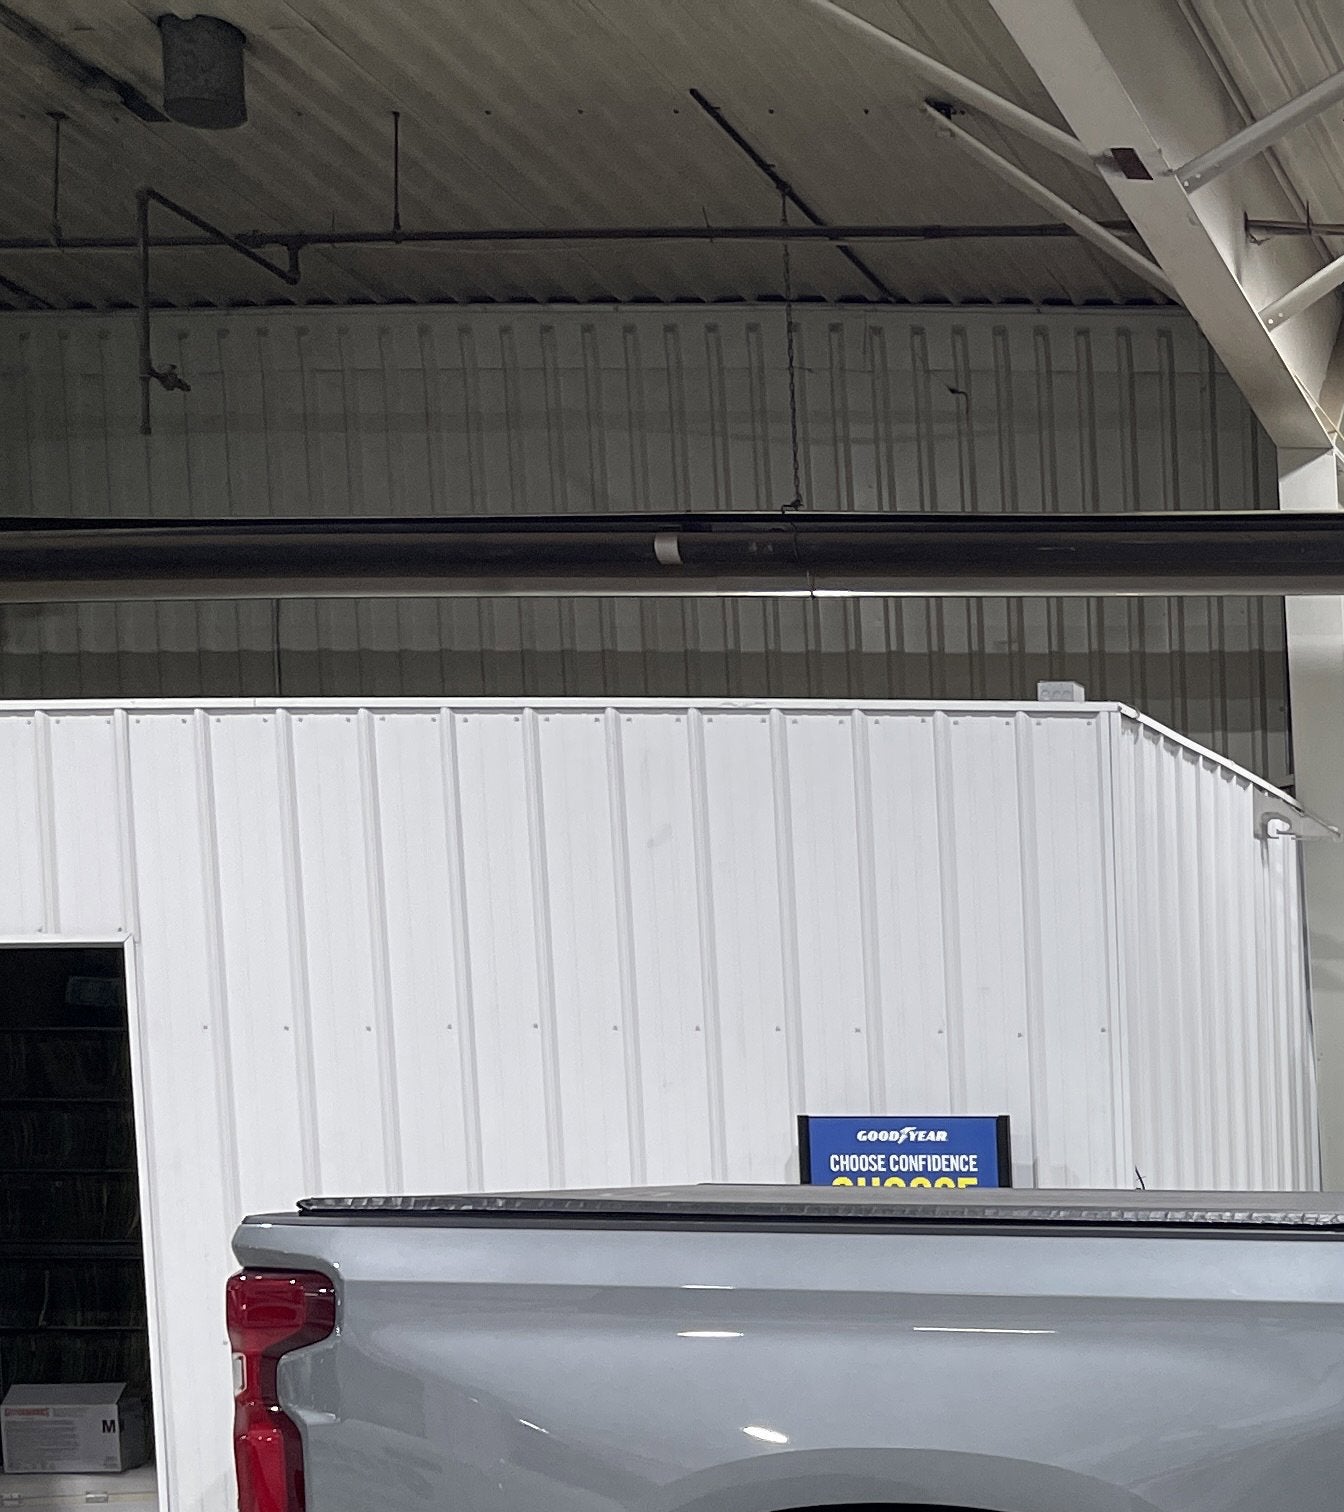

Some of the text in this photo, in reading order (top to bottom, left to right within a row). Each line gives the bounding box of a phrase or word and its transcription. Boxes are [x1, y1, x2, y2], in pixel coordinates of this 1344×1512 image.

[856, 1126, 948, 1144] GOODYEAR
[829, 1154, 978, 1172] CHOOSE CONFIDENCE
[102, 1419, 116, 1433] M
